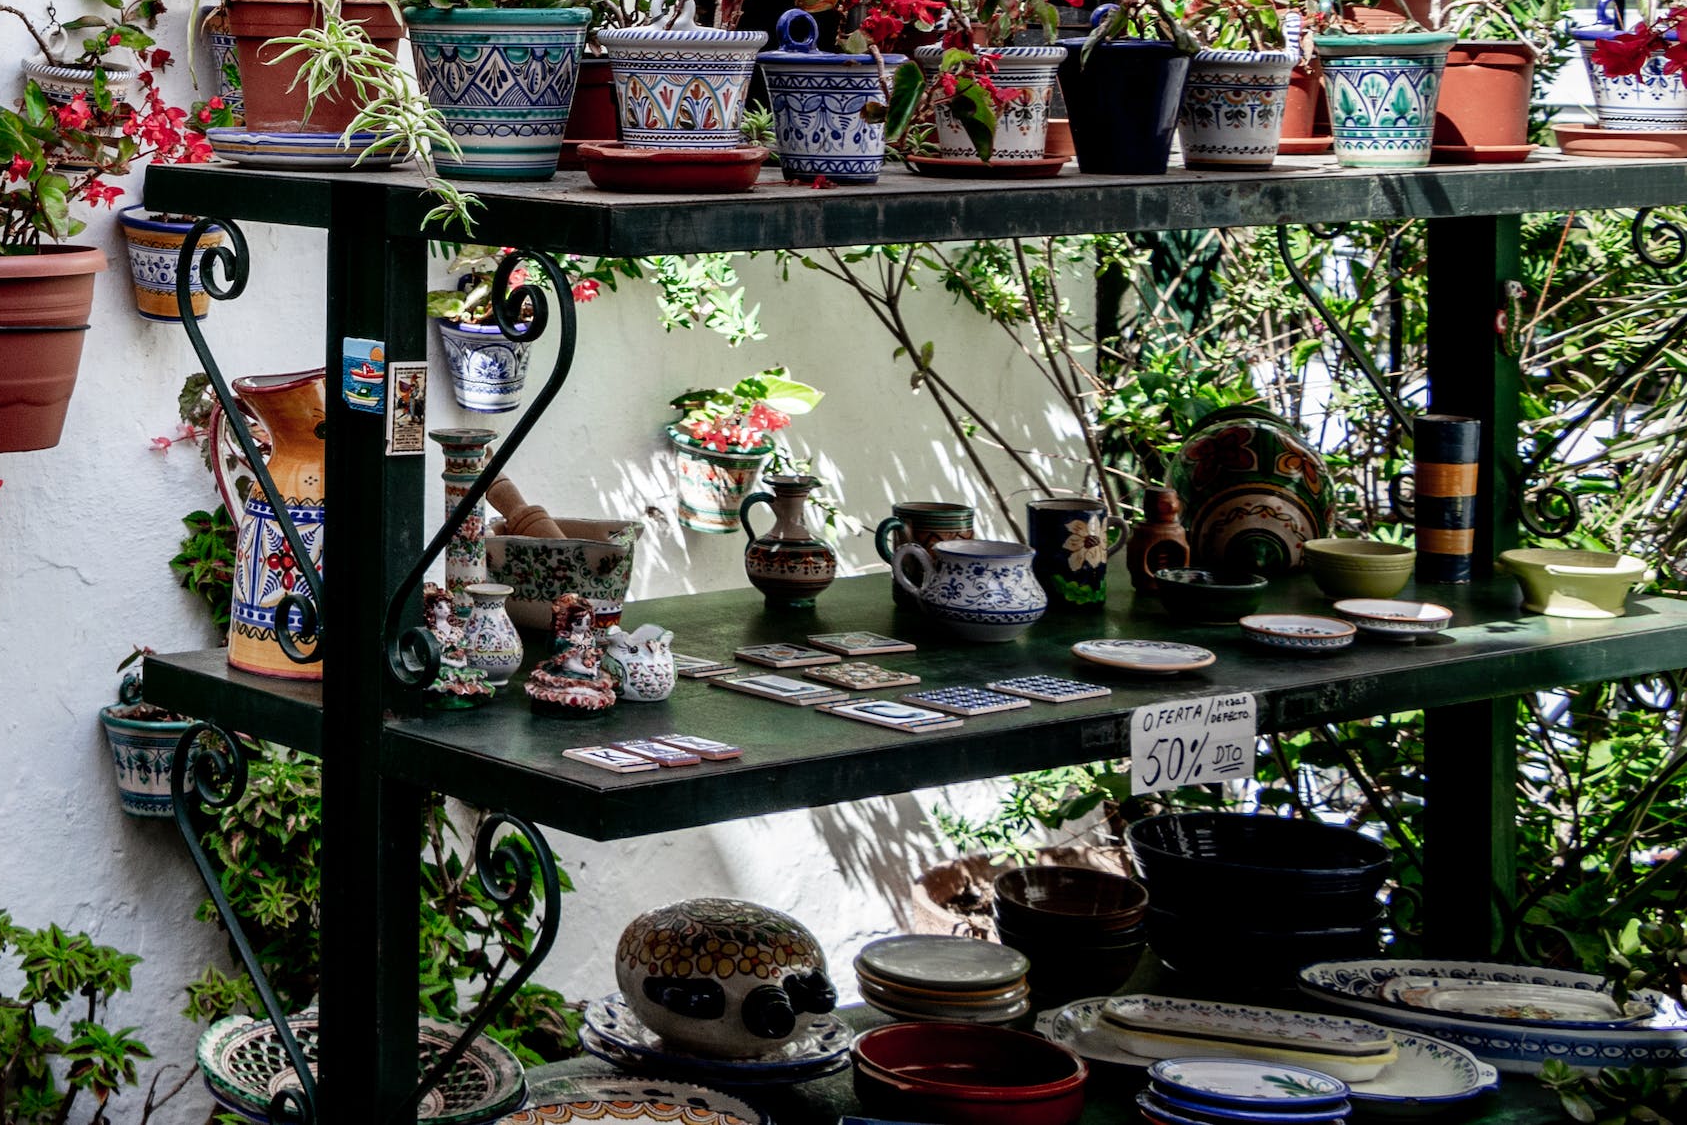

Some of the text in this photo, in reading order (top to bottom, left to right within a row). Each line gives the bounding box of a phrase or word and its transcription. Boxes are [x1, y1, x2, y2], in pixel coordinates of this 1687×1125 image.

[1143, 703, 1203, 732] OFERTA
[1141, 732, 1243, 787] 50% DTO
